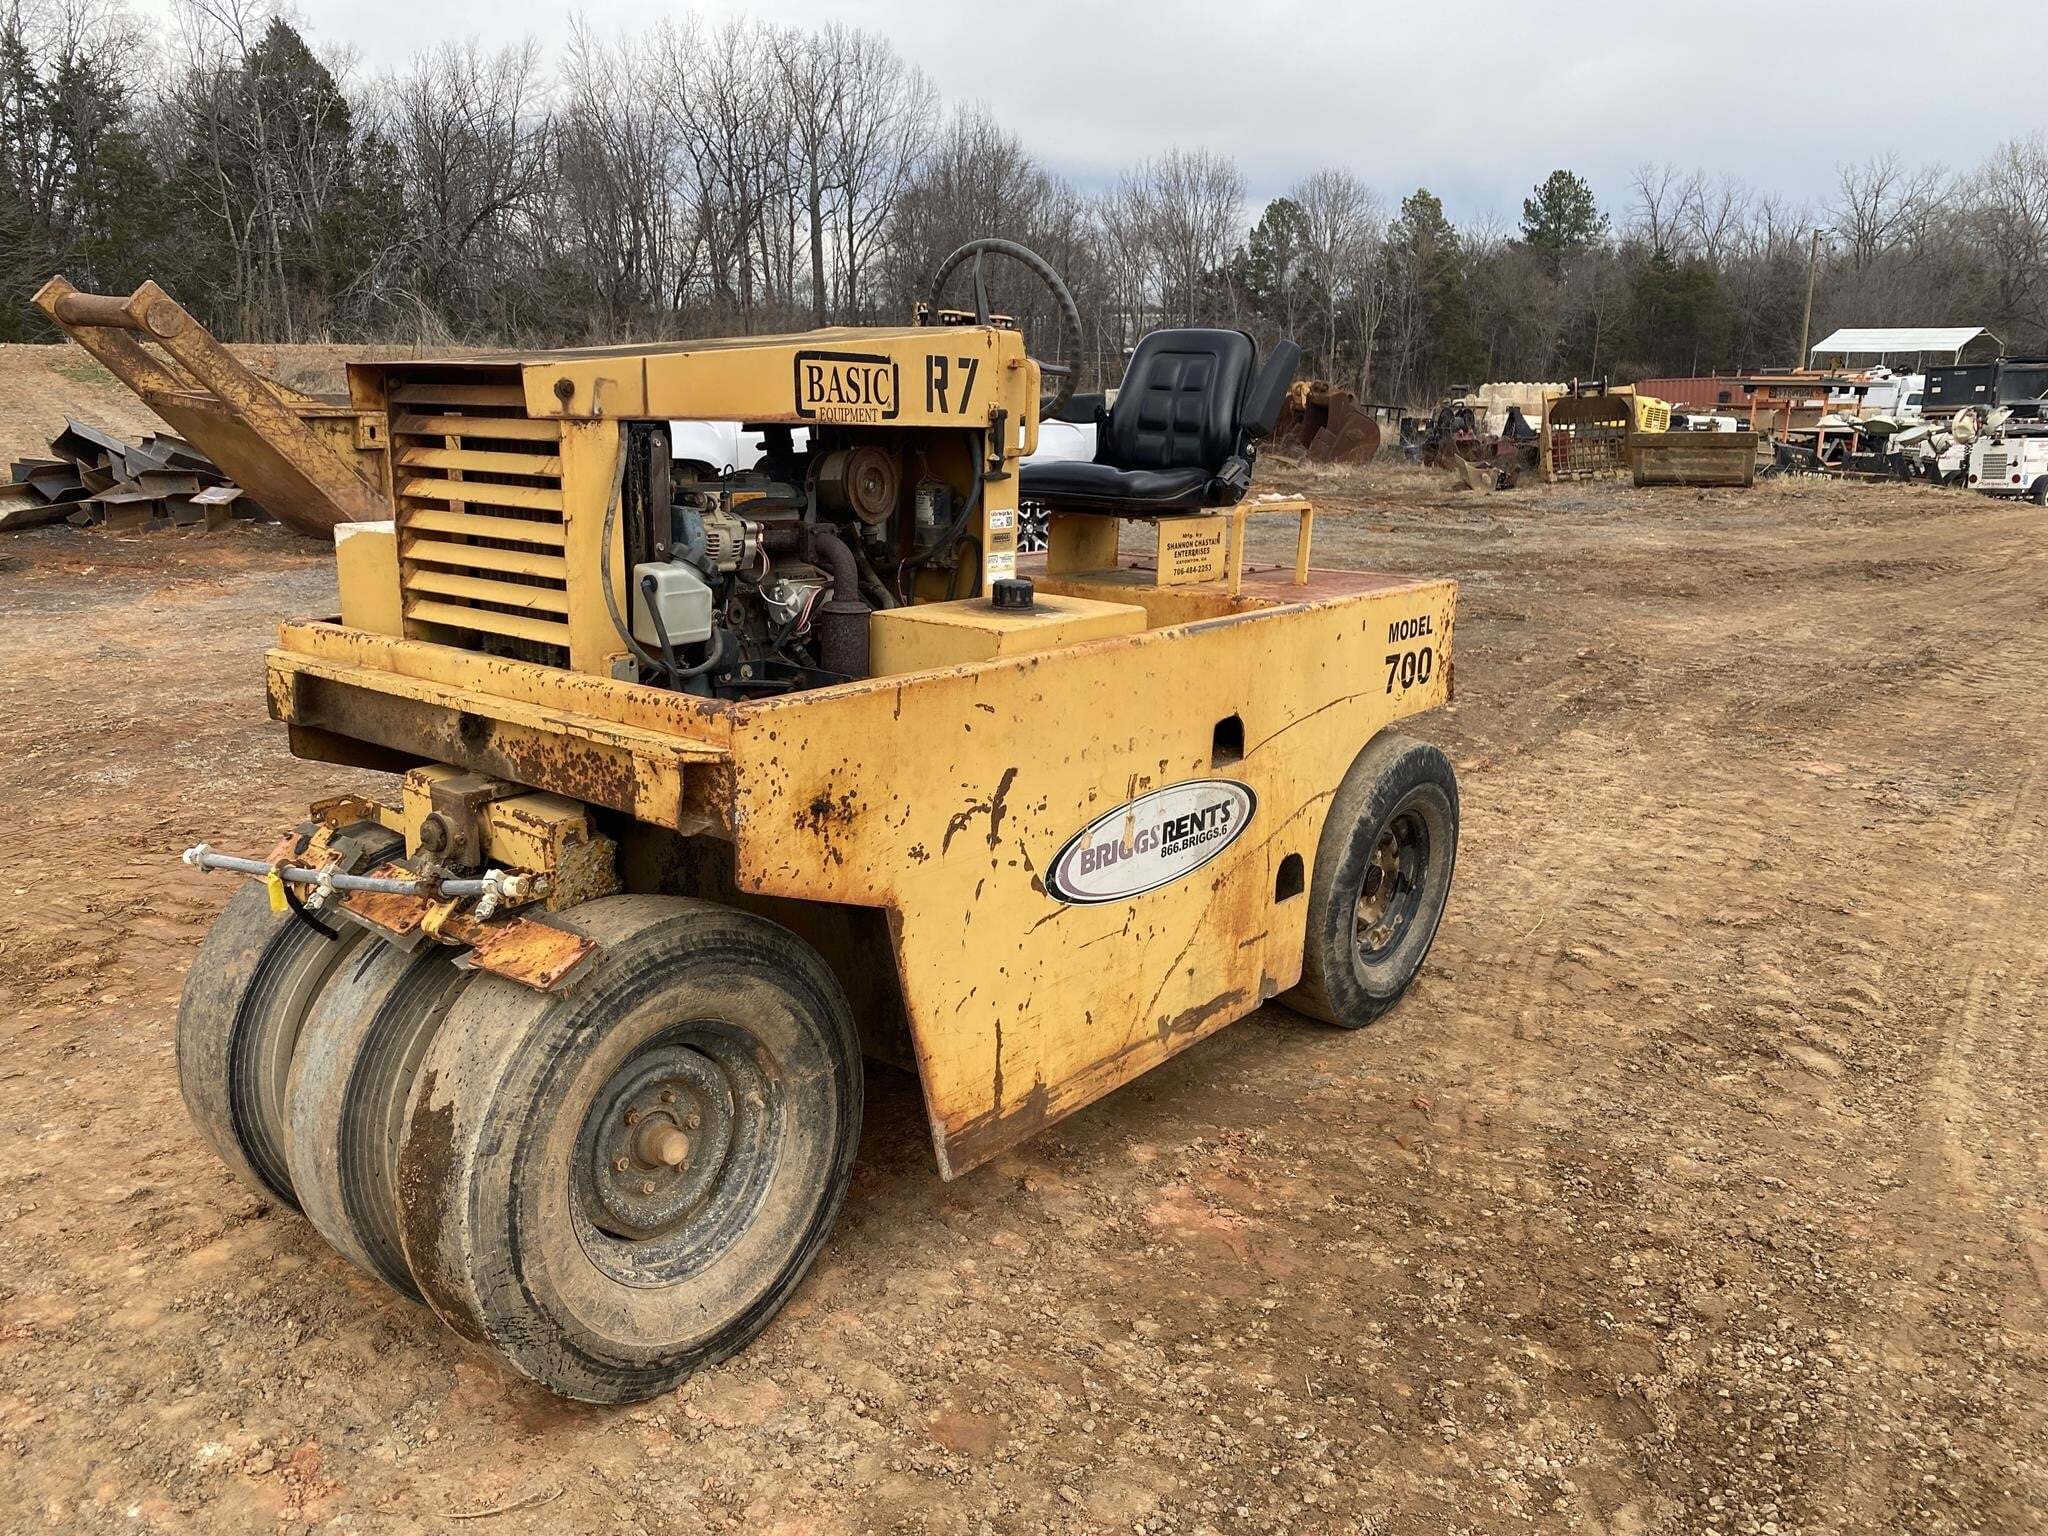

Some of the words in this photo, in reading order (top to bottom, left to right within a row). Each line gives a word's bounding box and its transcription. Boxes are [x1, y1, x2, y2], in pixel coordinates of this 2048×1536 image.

[806, 365, 890, 405] BASIC
[926, 355, 979, 414] R7
[819, 407, 878, 423] EQUIPMENT
[1167, 541, 1194, 551] SHANNON
[1174, 547, 1210, 558] ENTERPRISES
[1388, 615, 1433, 644] MODEL
[1385, 647, 1432, 694] 700
[1162, 801, 1231, 845] RENTS
